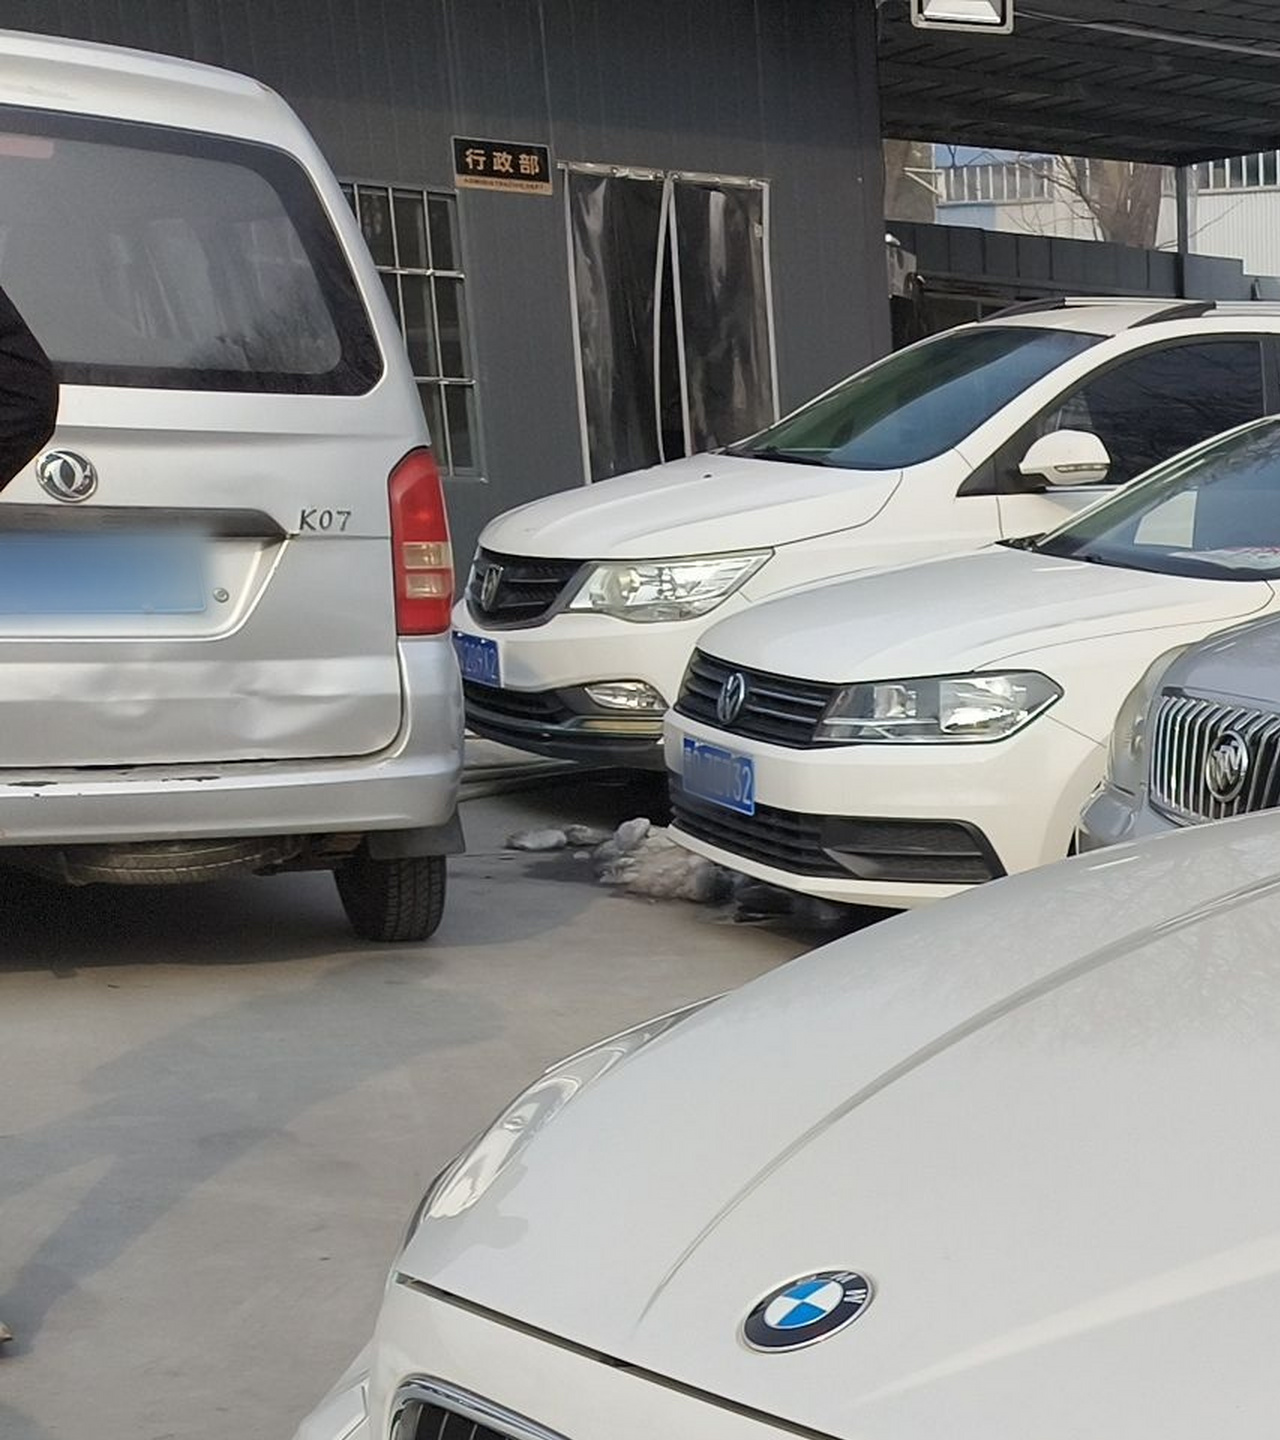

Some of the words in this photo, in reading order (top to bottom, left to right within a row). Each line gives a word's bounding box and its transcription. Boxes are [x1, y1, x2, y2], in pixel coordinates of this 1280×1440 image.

[465, 148, 540, 175] 行政部
[299, 509, 351, 531] K07
